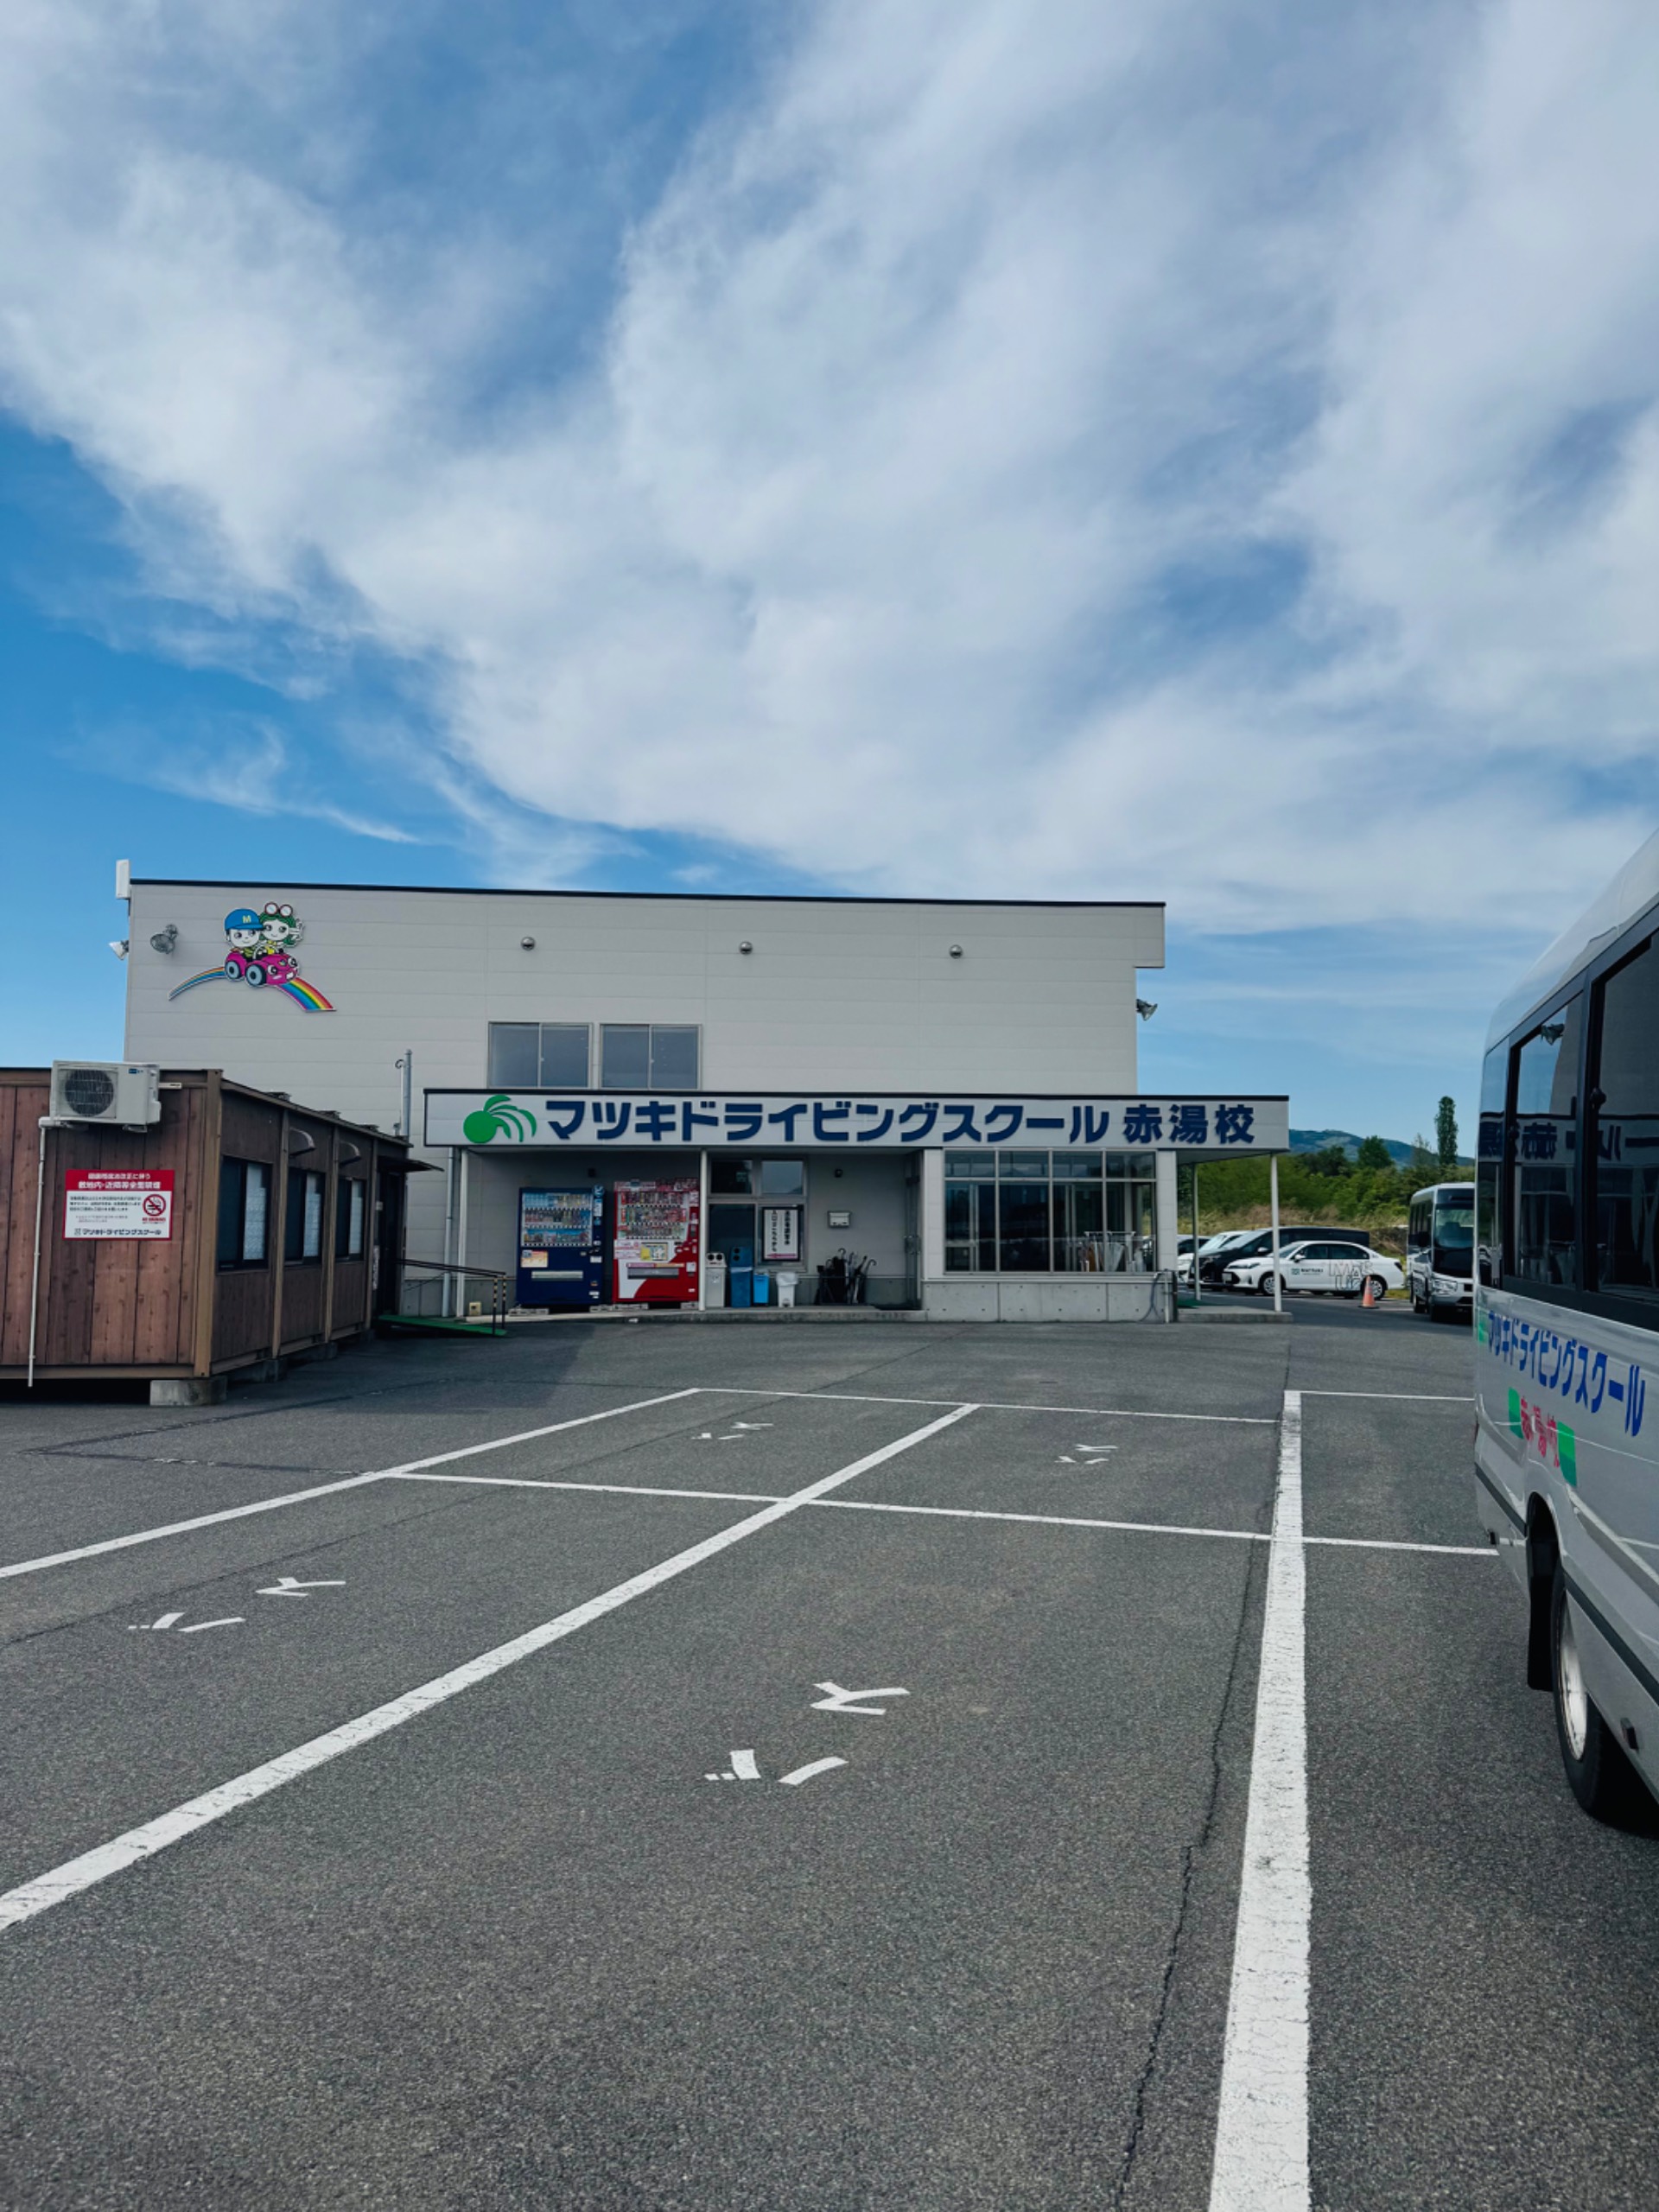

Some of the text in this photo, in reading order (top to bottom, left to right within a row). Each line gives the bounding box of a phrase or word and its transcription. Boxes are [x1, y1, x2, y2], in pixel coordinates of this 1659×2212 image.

[1488, 1310, 1645, 1436] マツキドライビングスクール
